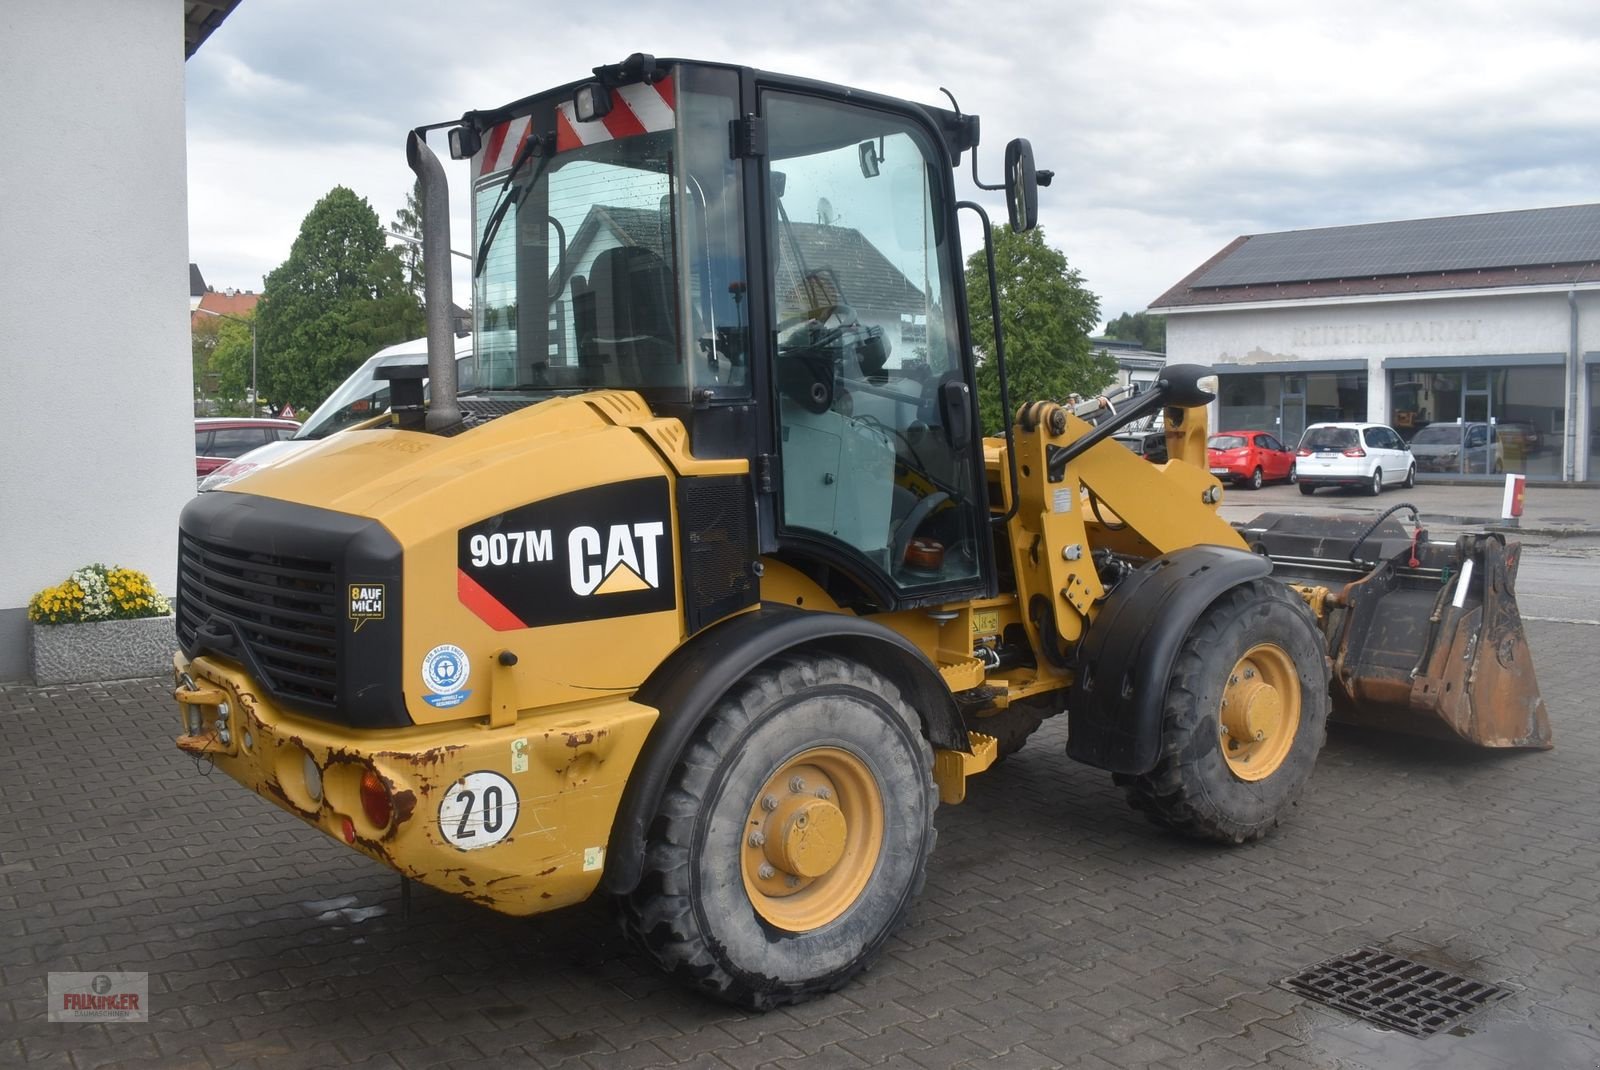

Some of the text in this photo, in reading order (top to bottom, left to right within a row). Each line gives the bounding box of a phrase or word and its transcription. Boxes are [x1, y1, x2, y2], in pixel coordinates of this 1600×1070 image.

[470, 521, 664, 597] 907M CAT
[352, 600, 382, 612] MICH
[433, 646, 450, 655] BLAUE
[450, 646, 465, 659] ENGEL
[456, 785, 503, 839] 20
